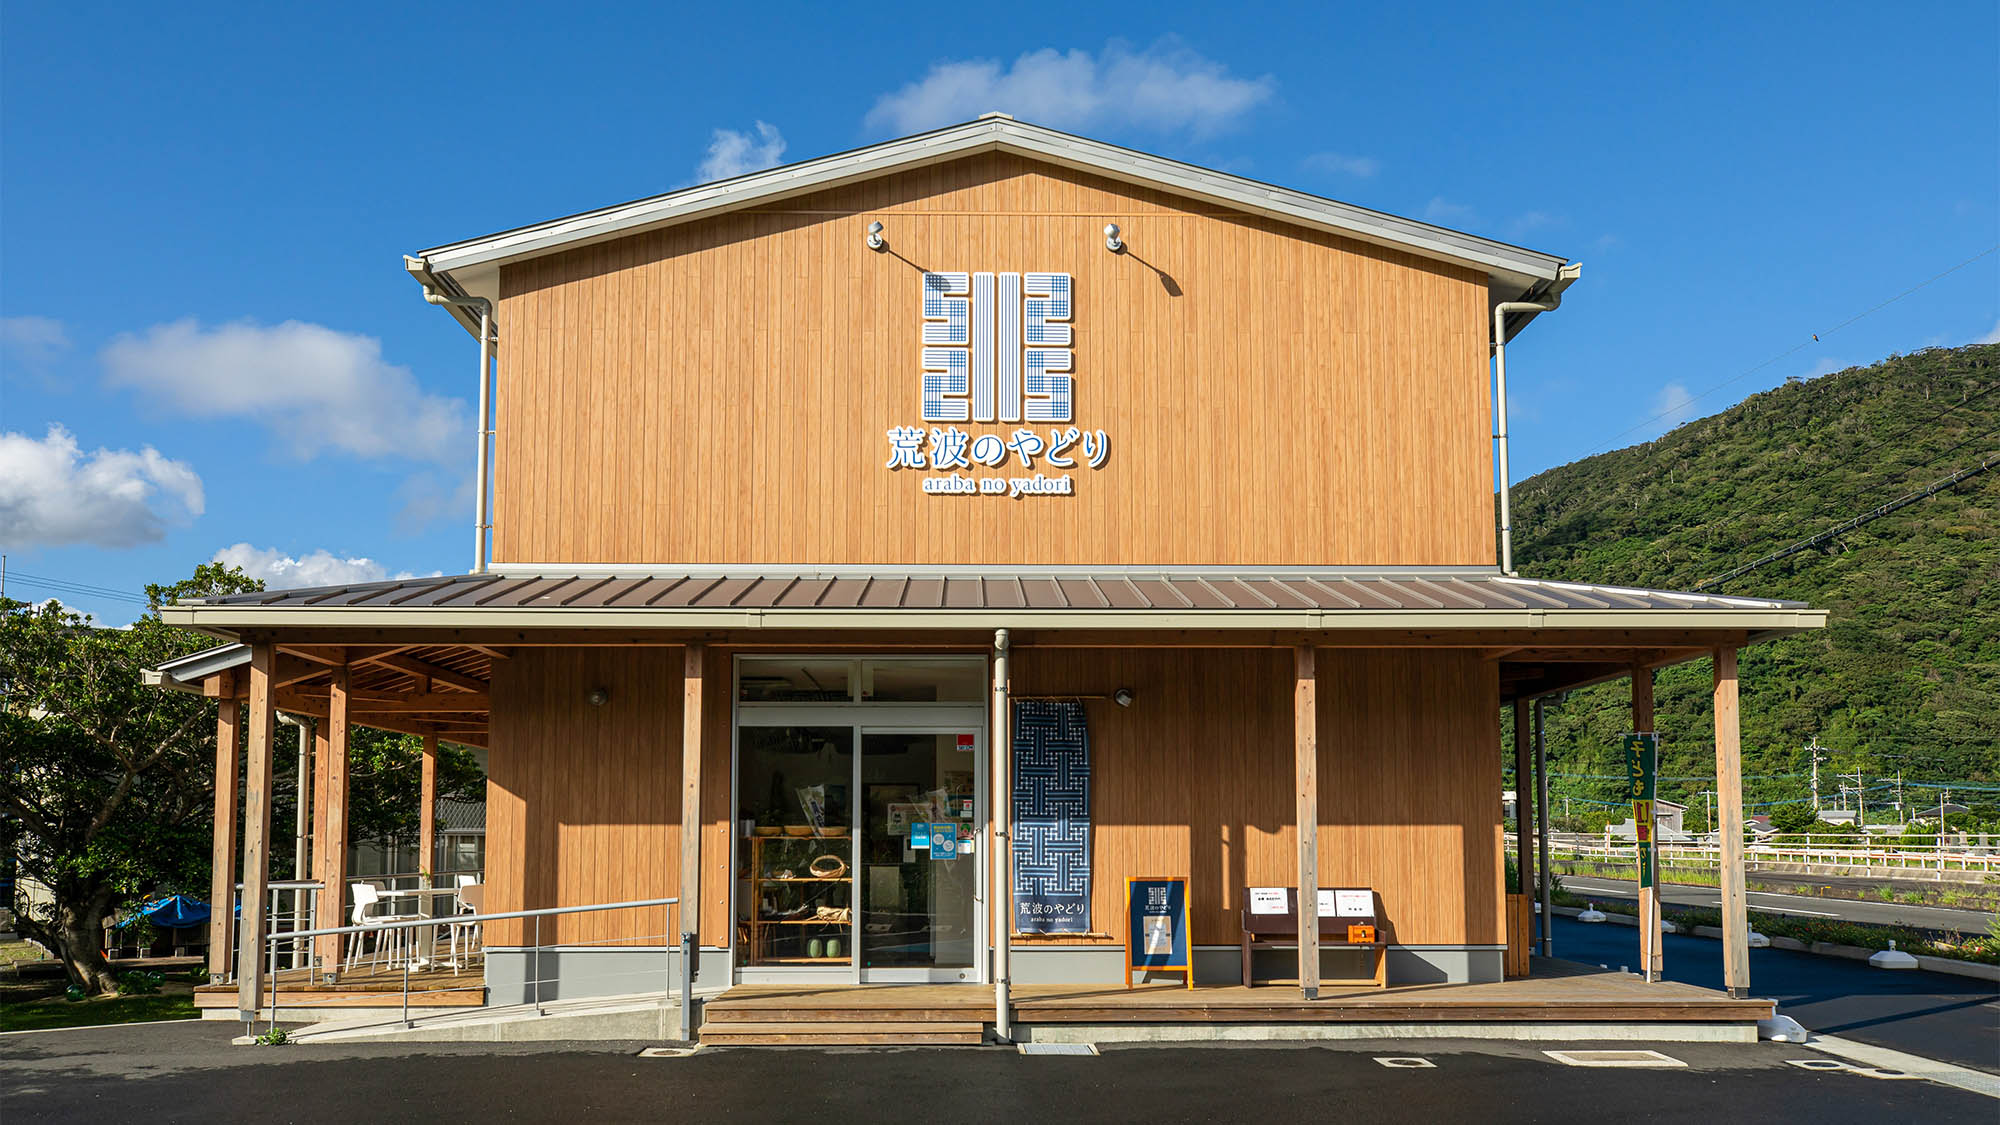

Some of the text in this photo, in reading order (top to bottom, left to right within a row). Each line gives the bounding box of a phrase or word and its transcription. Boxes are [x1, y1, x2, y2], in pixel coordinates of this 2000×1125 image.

[887, 427, 1107, 467] 荒波のやどり
[924, 475, 1070, 496] araba no yadori
[1020, 902, 1085, 915] 荒波のやどり
